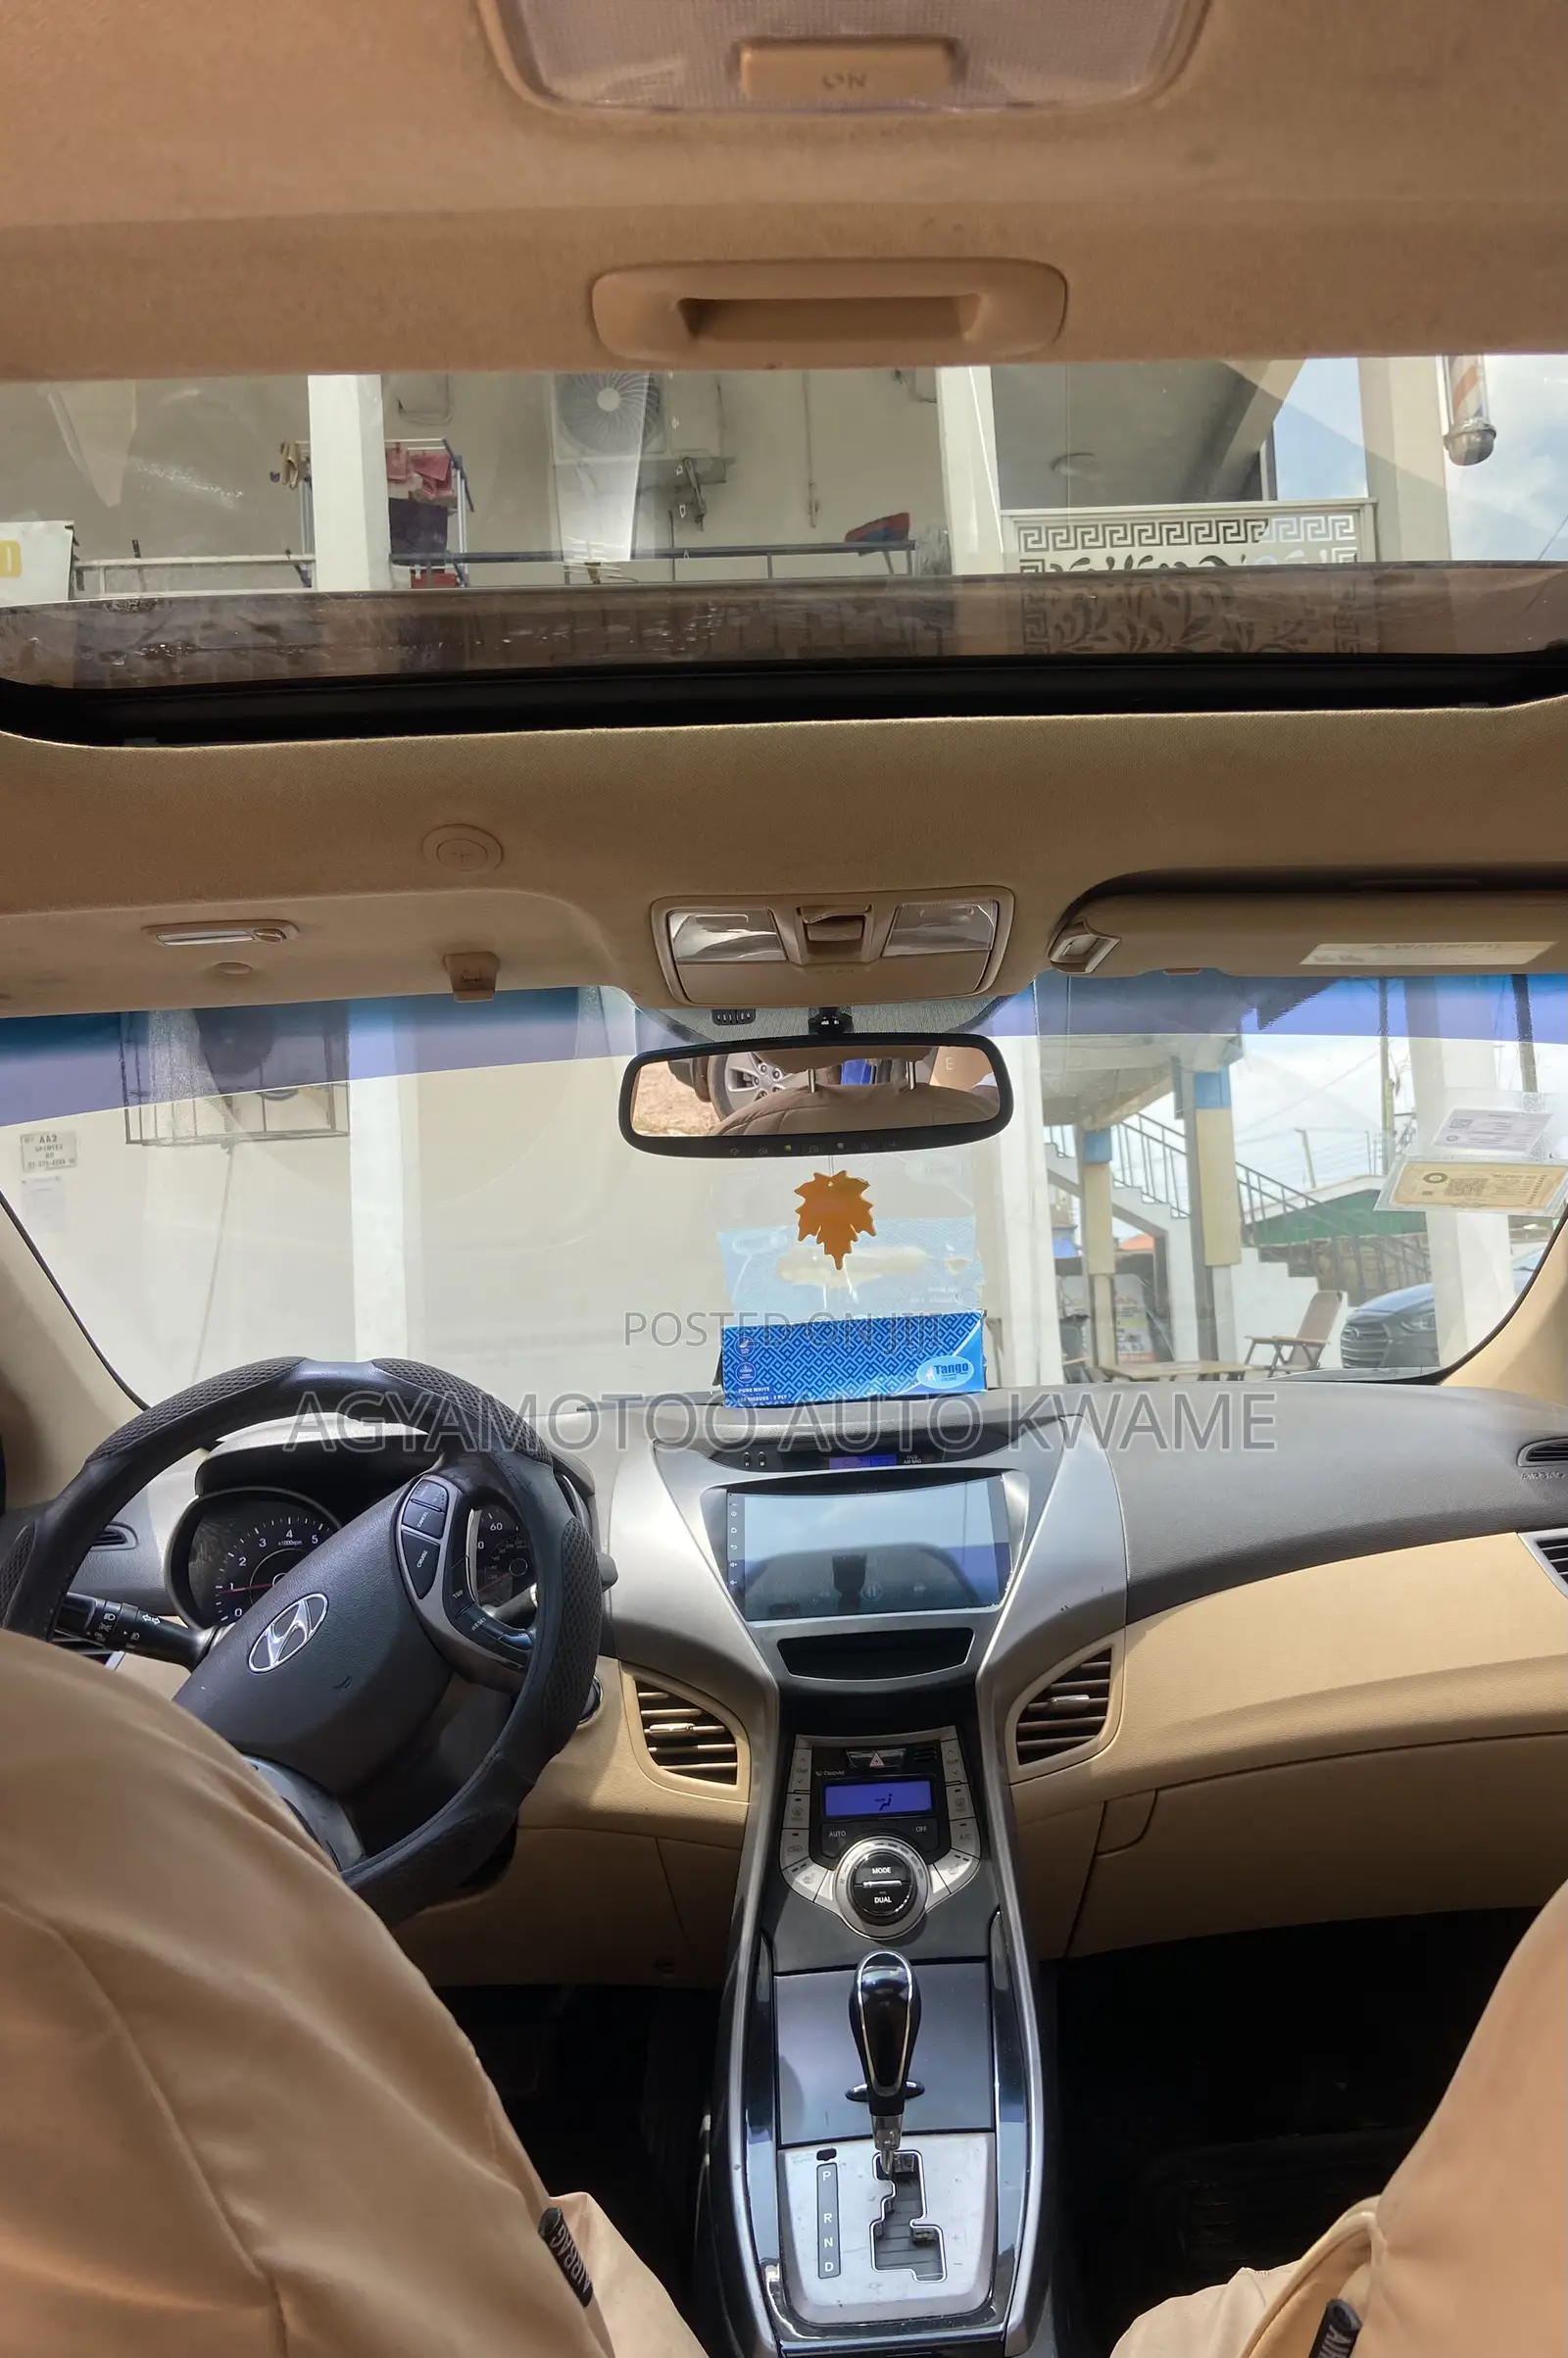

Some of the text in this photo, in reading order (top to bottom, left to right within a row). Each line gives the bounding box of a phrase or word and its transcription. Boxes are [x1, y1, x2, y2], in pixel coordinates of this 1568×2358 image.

[822, 72, 868, 90] ON
[934, 1362, 969, 1375] Tango
[490, 1522, 503, 1531] 60
[285, 1529, 293, 1538] 4
[259, 1539, 267, 1547] 3
[311, 1535, 318, 1545] 5
[238, 1556, 247, 1566] 2
[416, 1550, 428, 1568] CRUISE
[234, 1607, 243, 1617] 0
[872, 1866, 892, 1875] MODE
[874, 1895, 892, 1904] DUAL
[822, 2171, 832, 2182] P
[823, 2212, 833, 2224] R
[823, 2236, 834, 2248] N
[824, 2261, 835, 2273] D
